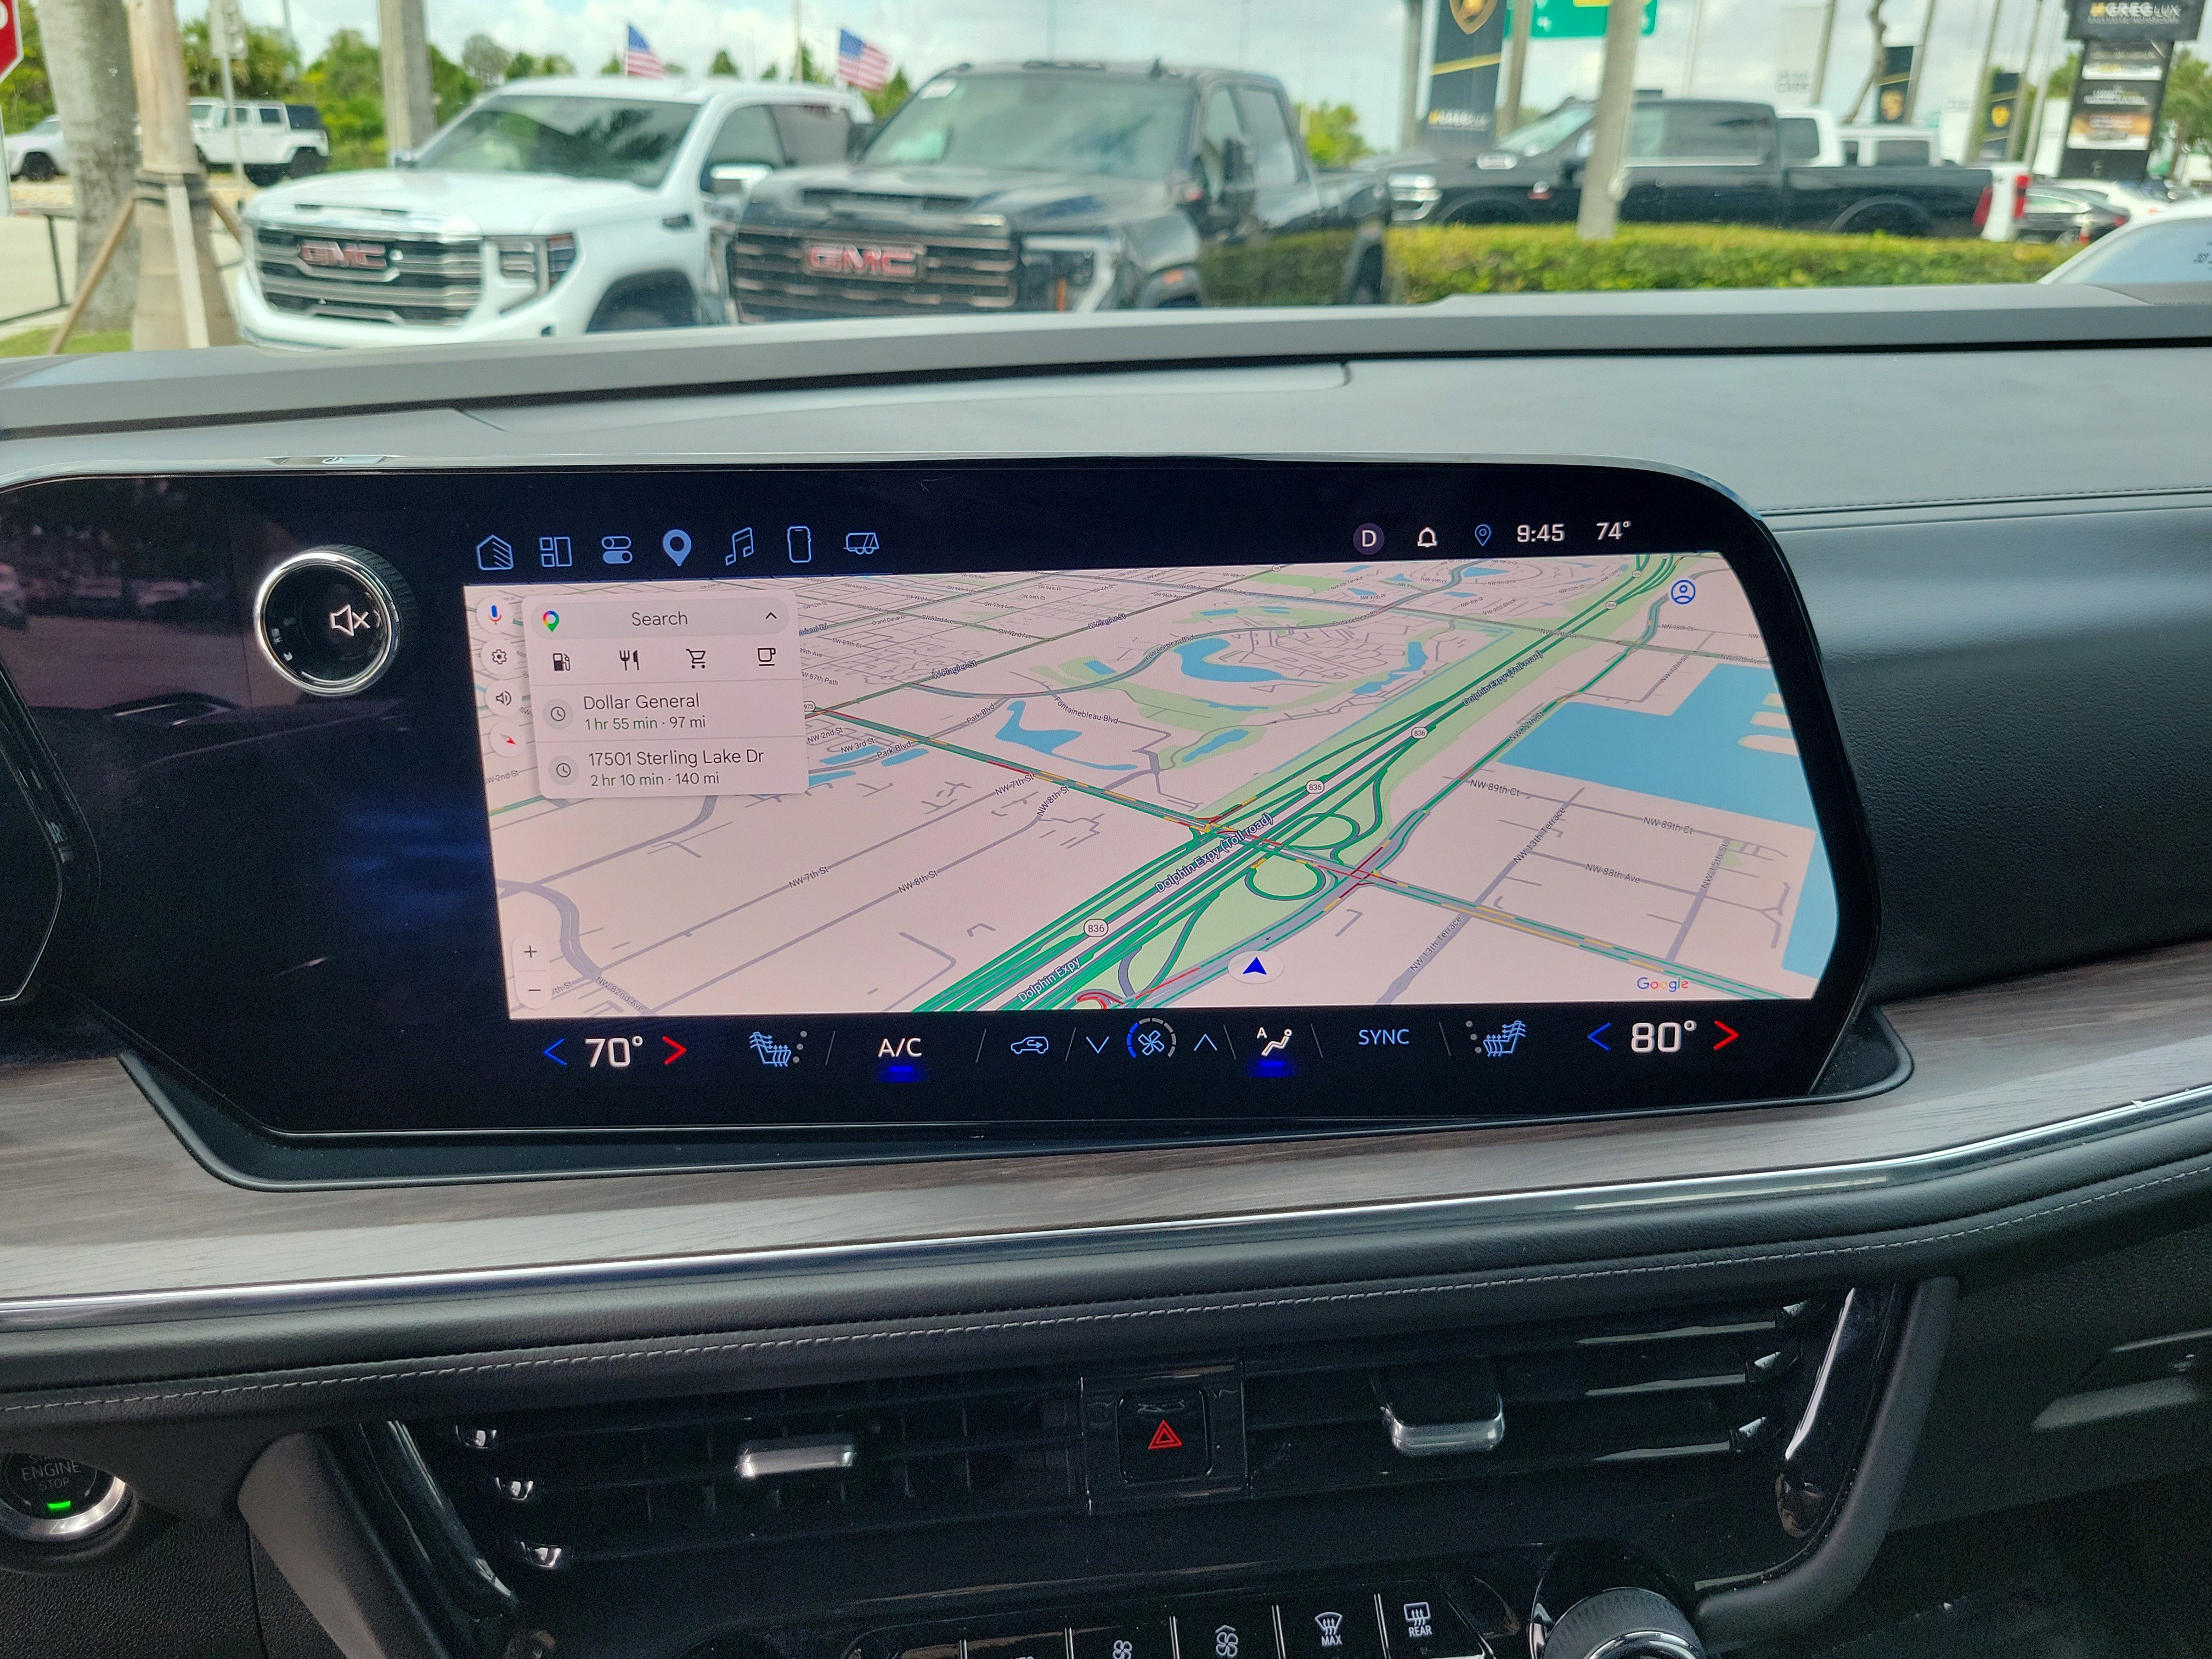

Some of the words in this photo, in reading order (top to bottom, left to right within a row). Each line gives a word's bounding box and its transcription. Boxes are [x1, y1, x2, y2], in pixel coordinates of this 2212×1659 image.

[300, 240, 387, 270] GMC
[806, 245, 918, 275] GMC
[1361, 529, 1376, 548] D
[1516, 523, 1566, 543] 9:45
[1595, 520, 1632, 541] 74°
[631, 611, 688, 627] Search
[1088, 622, 1096, 630] W
[1008, 630, 1021, 638] 92nd
[1181, 634, 1194, 644] Blvd
[932, 670, 941, 679] W
[941, 662, 967, 678] Flagler
[967, 659, 978, 670] St
[1462, 683, 1491, 706] Dolphin
[1489, 675, 1509, 690] Expy
[1522, 650, 1543, 668] road)
[810, 673, 823, 682] 87th
[824, 676, 839, 686] Path
[584, 695, 630, 710] Dollar
[635, 692, 699, 709] General
[1054, 696, 1102, 721] Fontainebleau
[1101, 714, 1119, 725] Blvd
[585, 719, 590, 731] 1
[594, 718, 608, 730] hr
[613, 718, 629, 730] 55
[633, 716, 658, 730] min
[669, 716, 685, 729] 97
[690, 715, 706, 728] mi
[966, 712, 981, 724] Park
[980, 703, 995, 716] Blvd
[807, 733, 820, 743] NW
[821, 730, 835, 740] 2nd
[836, 726, 844, 735] St
[1509, 727, 1522, 742] NW
[1522, 717, 1538, 732] 12th
[1535, 710, 1544, 721] St
[840, 743, 855, 753] NW
[855, 740, 867, 749] 3rd
[877, 747, 894, 758] Park
[895, 741, 912, 752] Blvd
[588, 752, 632, 766] 17501
[636, 749, 698, 768] Sterling
[703, 748, 741, 764] Lake
[746, 749, 765, 764] Dr
[495, 772, 510, 781] 2nd
[590, 774, 599, 787] 2
[602, 774, 616, 787] hr
[620, 774, 635, 786] 10
[639, 772, 664, 786] min
[675, 772, 699, 785] 140
[704, 771, 720, 784] mi
[995, 783, 1009, 795] NW
[1009, 778, 1025, 789] 7th
[1025, 774, 1035, 782] St
[1470, 779, 1486, 789] NW
[1487, 783, 1508, 794] 89th
[1510, 788, 1520, 797] Ct
[1036, 801, 1049, 817] NW
[1046, 791, 1062, 805] 8th
[1060, 785, 1070, 794] St
[1513, 849, 1528, 864] NW
[1526, 833, 1544, 850] 13th
[1541, 807, 1566, 834] Terrace
[1643, 816, 1660, 827] NW
[1662, 821, 1681, 833] 89th
[1683, 825, 1694, 835] Ct
[1154, 863, 1197, 893] Dolphin
[1193, 847, 1221, 872] Expy
[1220, 828, 1248, 854] (Toll
[1244, 812, 1274, 838] road)
[1585, 863, 1602, 873] NW
[1602, 867, 1622, 879] 88th
[1624, 873, 1640, 884] Ave
[1700, 873, 1713, 889] NW
[1709, 852, 1724, 873] 15th
[1718, 843, 1728, 853] St
[788, 876, 804, 889] NW
[804, 870, 819, 882] 7th
[819, 865, 830, 875] St
[898, 882, 914, 894] NW
[913, 875, 928, 886] 8th
[928, 870, 939, 879] St
[1087, 924, 1105, 933] 836
[1409, 955, 1425, 972] NW
[1422, 937, 1440, 957] 13th
[1435, 915, 1463, 941] Terrace
[1017, 974, 1057, 1003] Dolphin
[1054, 956, 1081, 979] Expy
[1636, 976, 1690, 993] Google
[596, 976, 611, 988] NW
[611, 984, 630, 1001] 82nd
[629, 997, 645, 1012] Ave
[1357, 1028, 1410, 1046] SYNC
[1630, 1019, 1697, 1053] 80°
[584, 1035, 644, 1068] 70°
[878, 1037, 923, 1059] A/C
[21, 1460, 82, 1482] ENGINE
[39, 1477, 70, 1491] STOP
[1321, 1634, 1343, 1646] MAX
[1408, 1625, 1433, 1638] REAR
